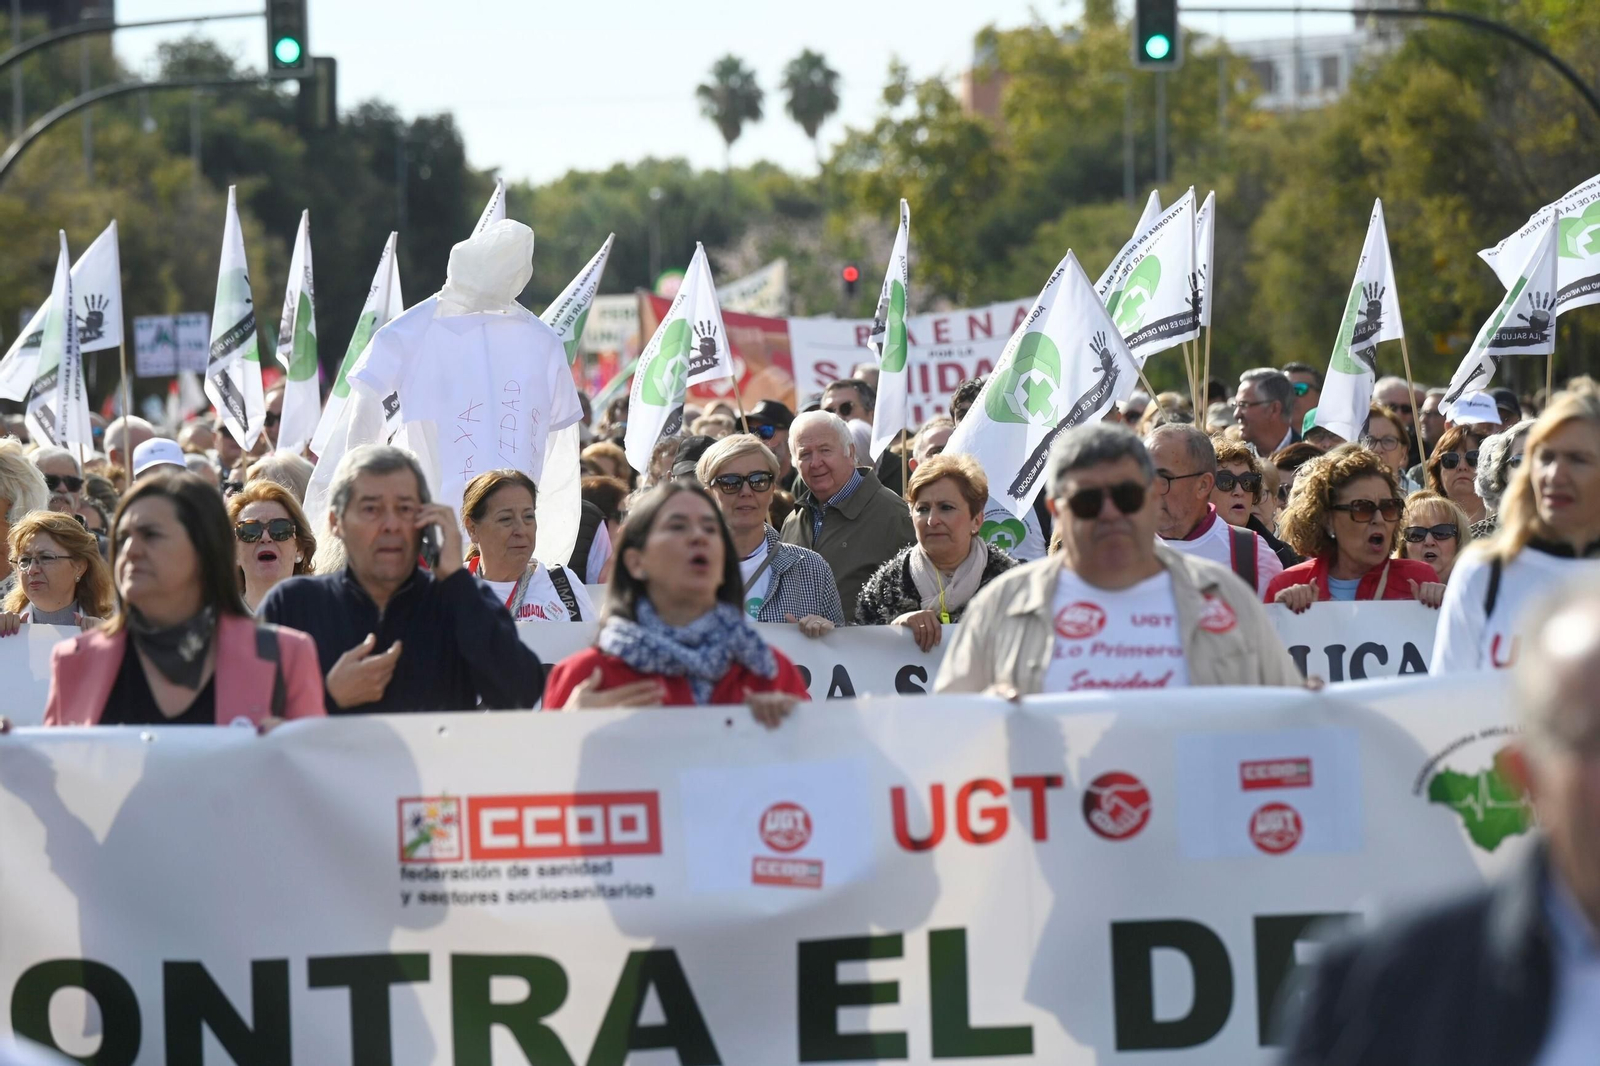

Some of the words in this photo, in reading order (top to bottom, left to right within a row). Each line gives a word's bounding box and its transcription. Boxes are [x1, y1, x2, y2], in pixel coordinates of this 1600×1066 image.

[213, 374, 224, 387] NO
[556, 575, 578, 618] BIMBA
[1131, 613, 1175, 627] UGT
[766, 808, 804, 832] UGT
[890, 773, 1064, 853] UGT
[479, 802, 650, 850] CCOO
[400, 863, 501, 882] federación
[506, 863, 530, 879] de
[536, 860, 614, 878] sanidad
[400, 889, 411, 907] y
[418, 888, 500, 905] sectores
[506, 882, 656, 903] sociosanitarios
[797, 925, 1034, 1064] EL
